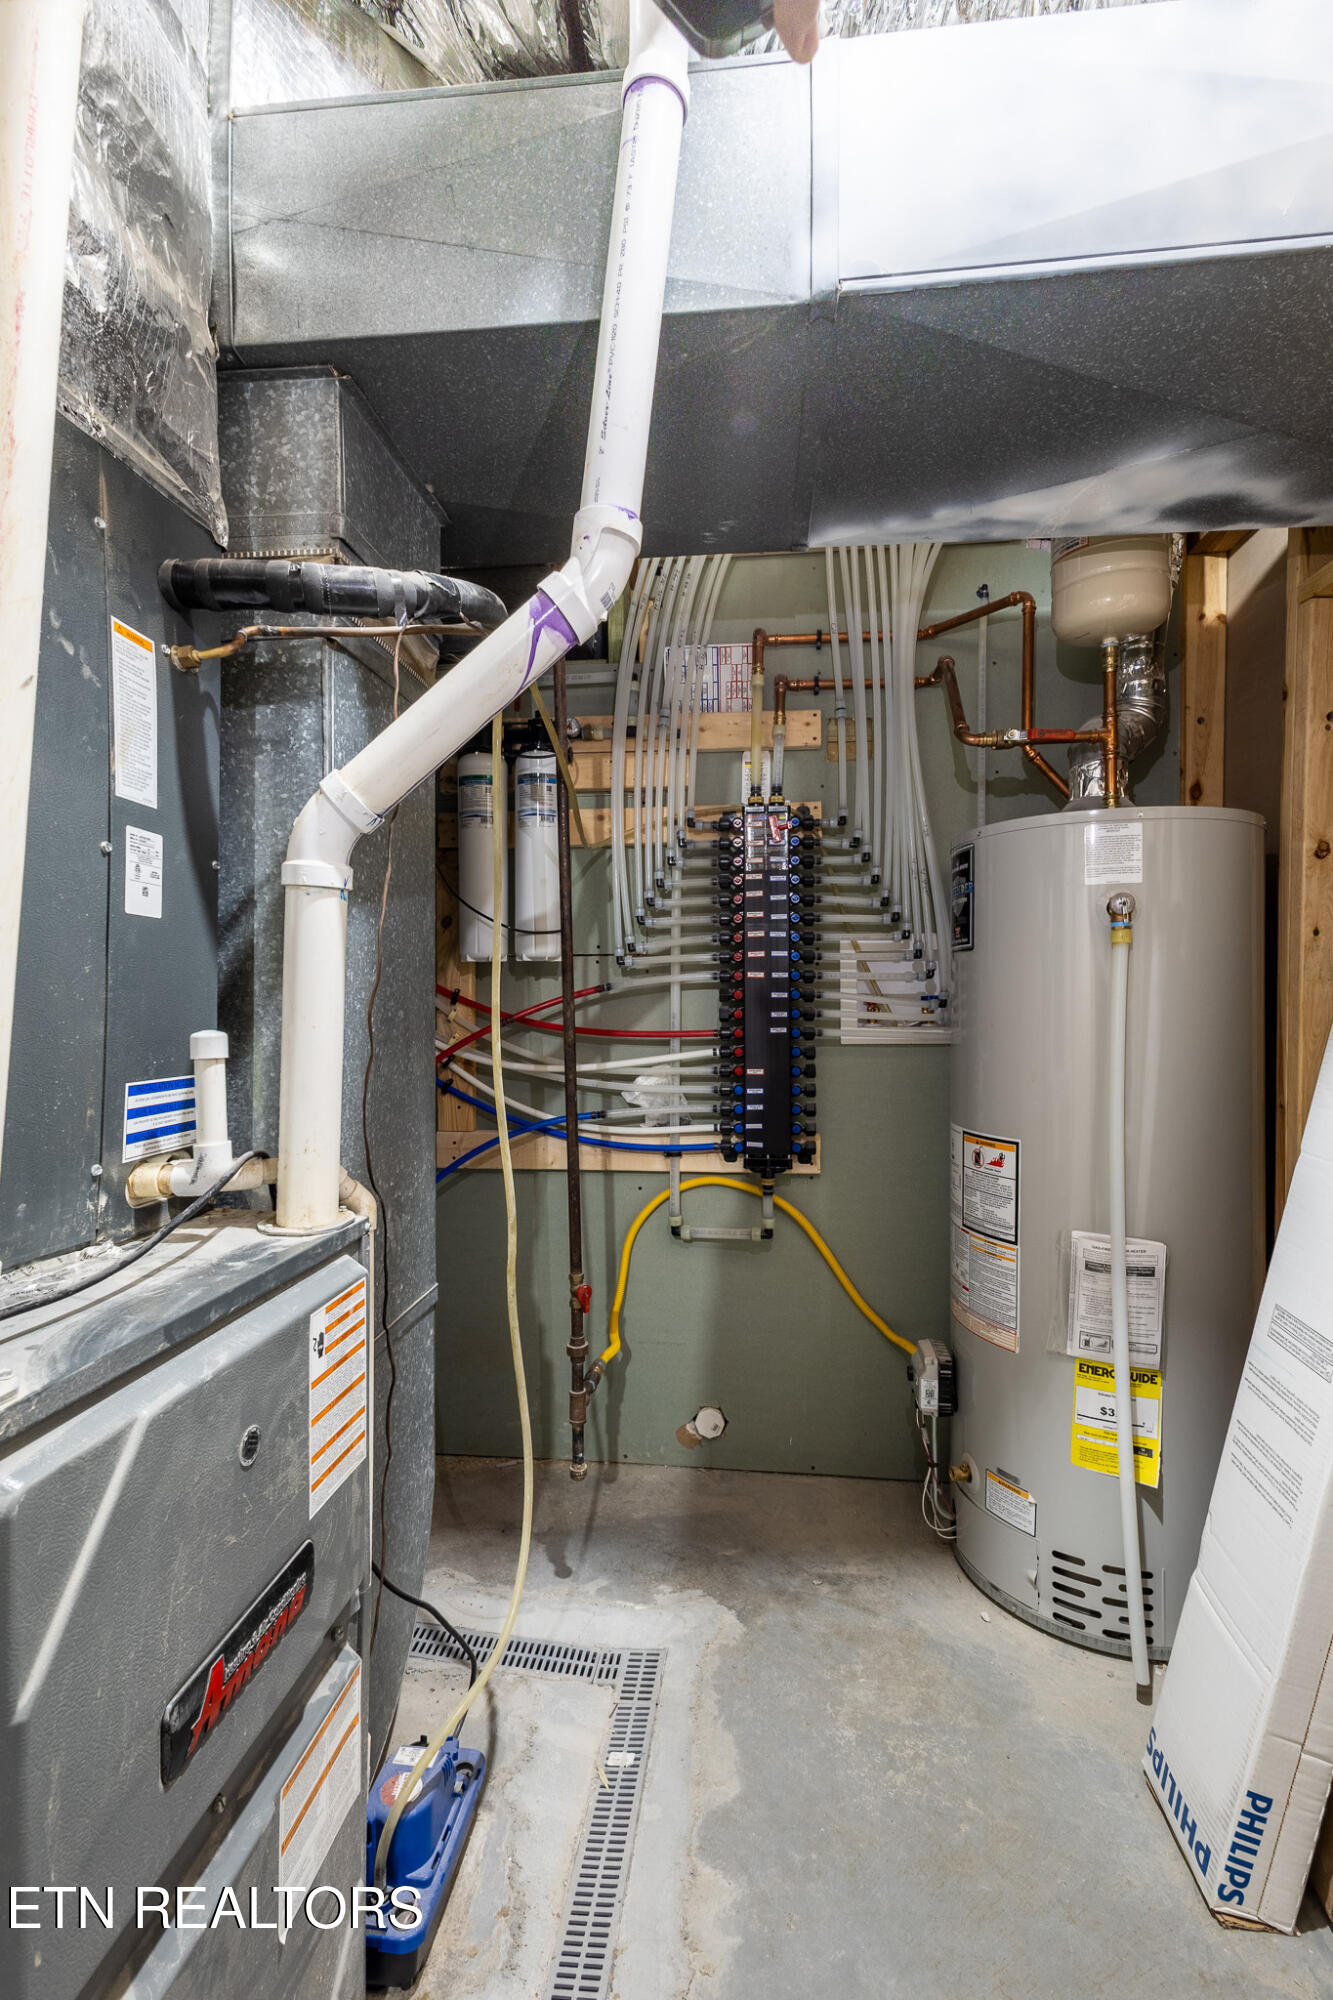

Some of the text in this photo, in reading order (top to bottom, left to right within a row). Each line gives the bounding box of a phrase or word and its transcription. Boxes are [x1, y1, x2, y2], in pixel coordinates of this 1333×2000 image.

[186, 1584, 307, 1760] Amana
[1146, 1726, 1212, 1878] PHILIPS
[1217, 1790, 1274, 1906] PHILIPS
